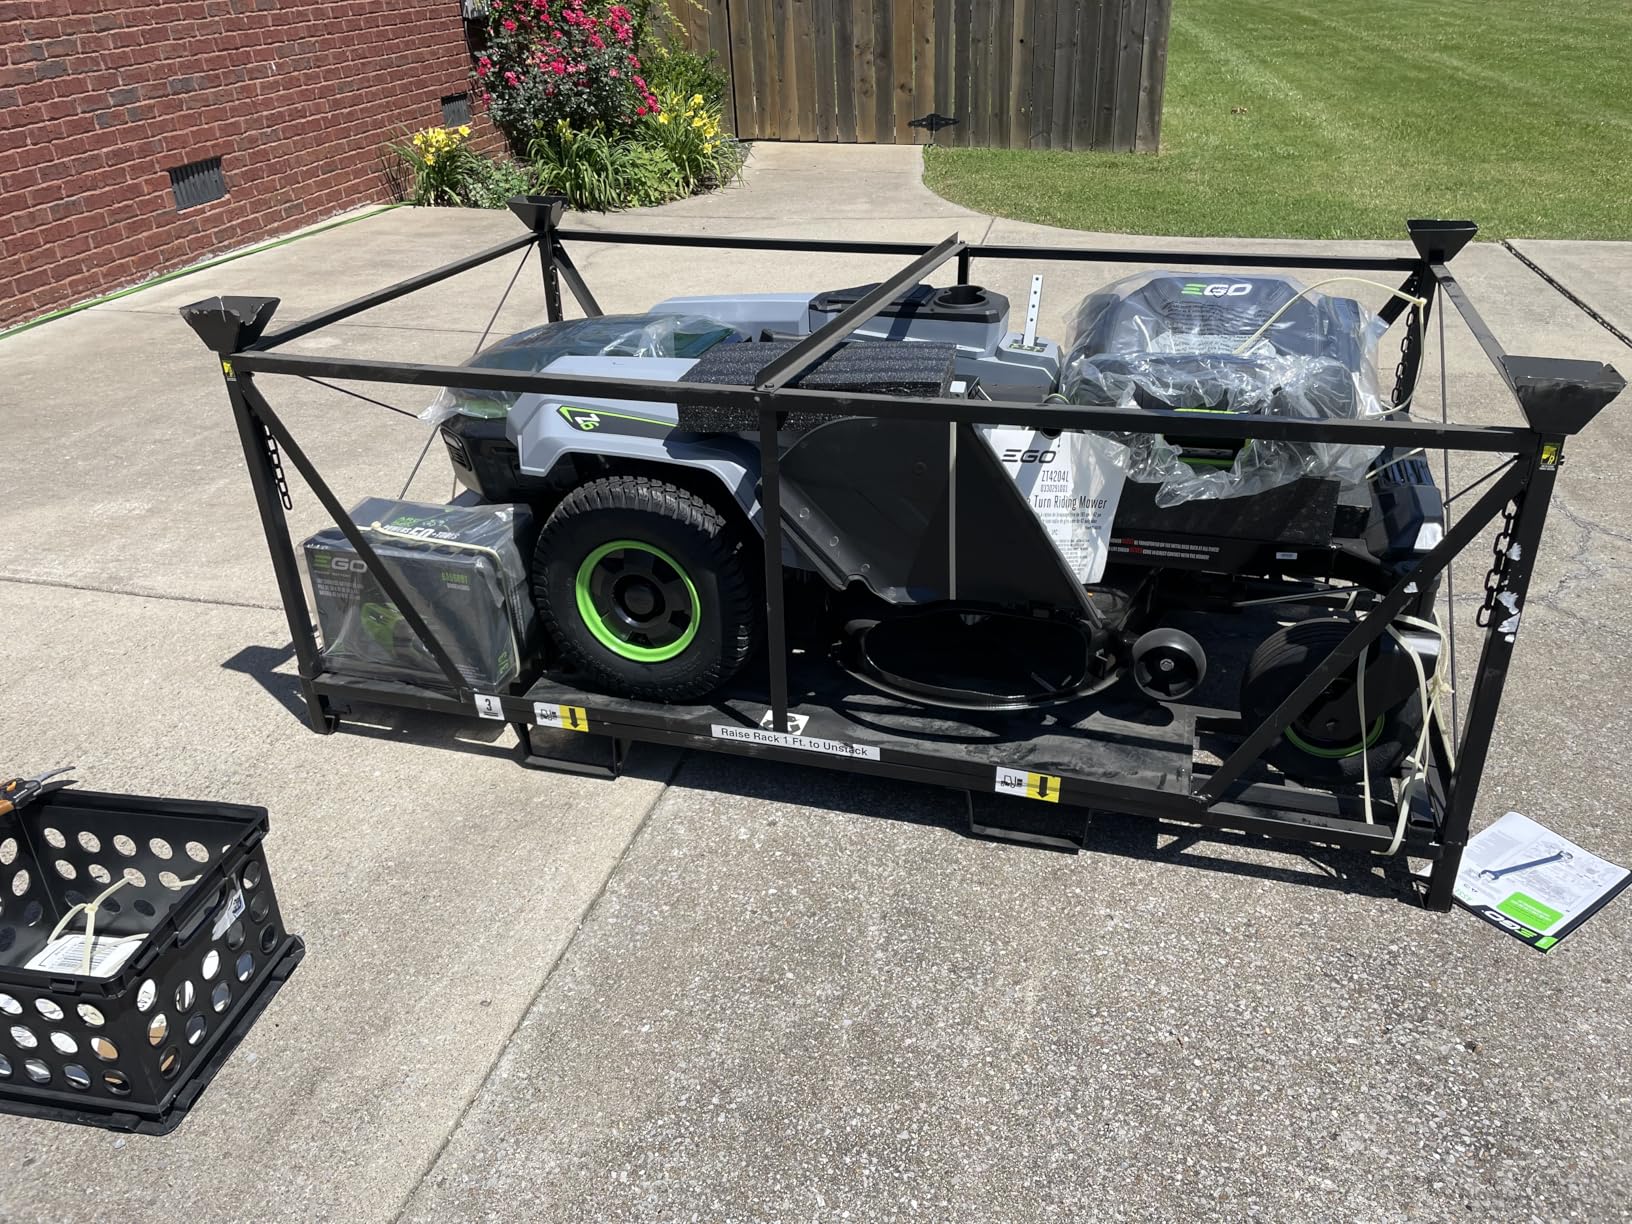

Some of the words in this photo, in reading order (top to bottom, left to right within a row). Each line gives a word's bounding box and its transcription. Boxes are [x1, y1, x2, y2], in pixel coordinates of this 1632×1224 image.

[1181, 283, 1253, 296] EGO
[1001, 449, 1057, 464] EGO
[1041, 470, 1070, 482] ZT4204L
[1034, 495, 1052, 508] Turn
[1053, 496, 1077, 510] Riding
[1079, 495, 1108, 509] Mower
[313, 554, 368, 573] EGO
[484, 698, 492, 711] 3
[721, 727, 750, 740] Raise
[753, 731, 780, 744] Rack
[783, 736, 788, 745] 1
[792, 737, 806, 747] Ft.
[809, 739, 820, 749] to
[823, 742, 868, 756] Unstack
